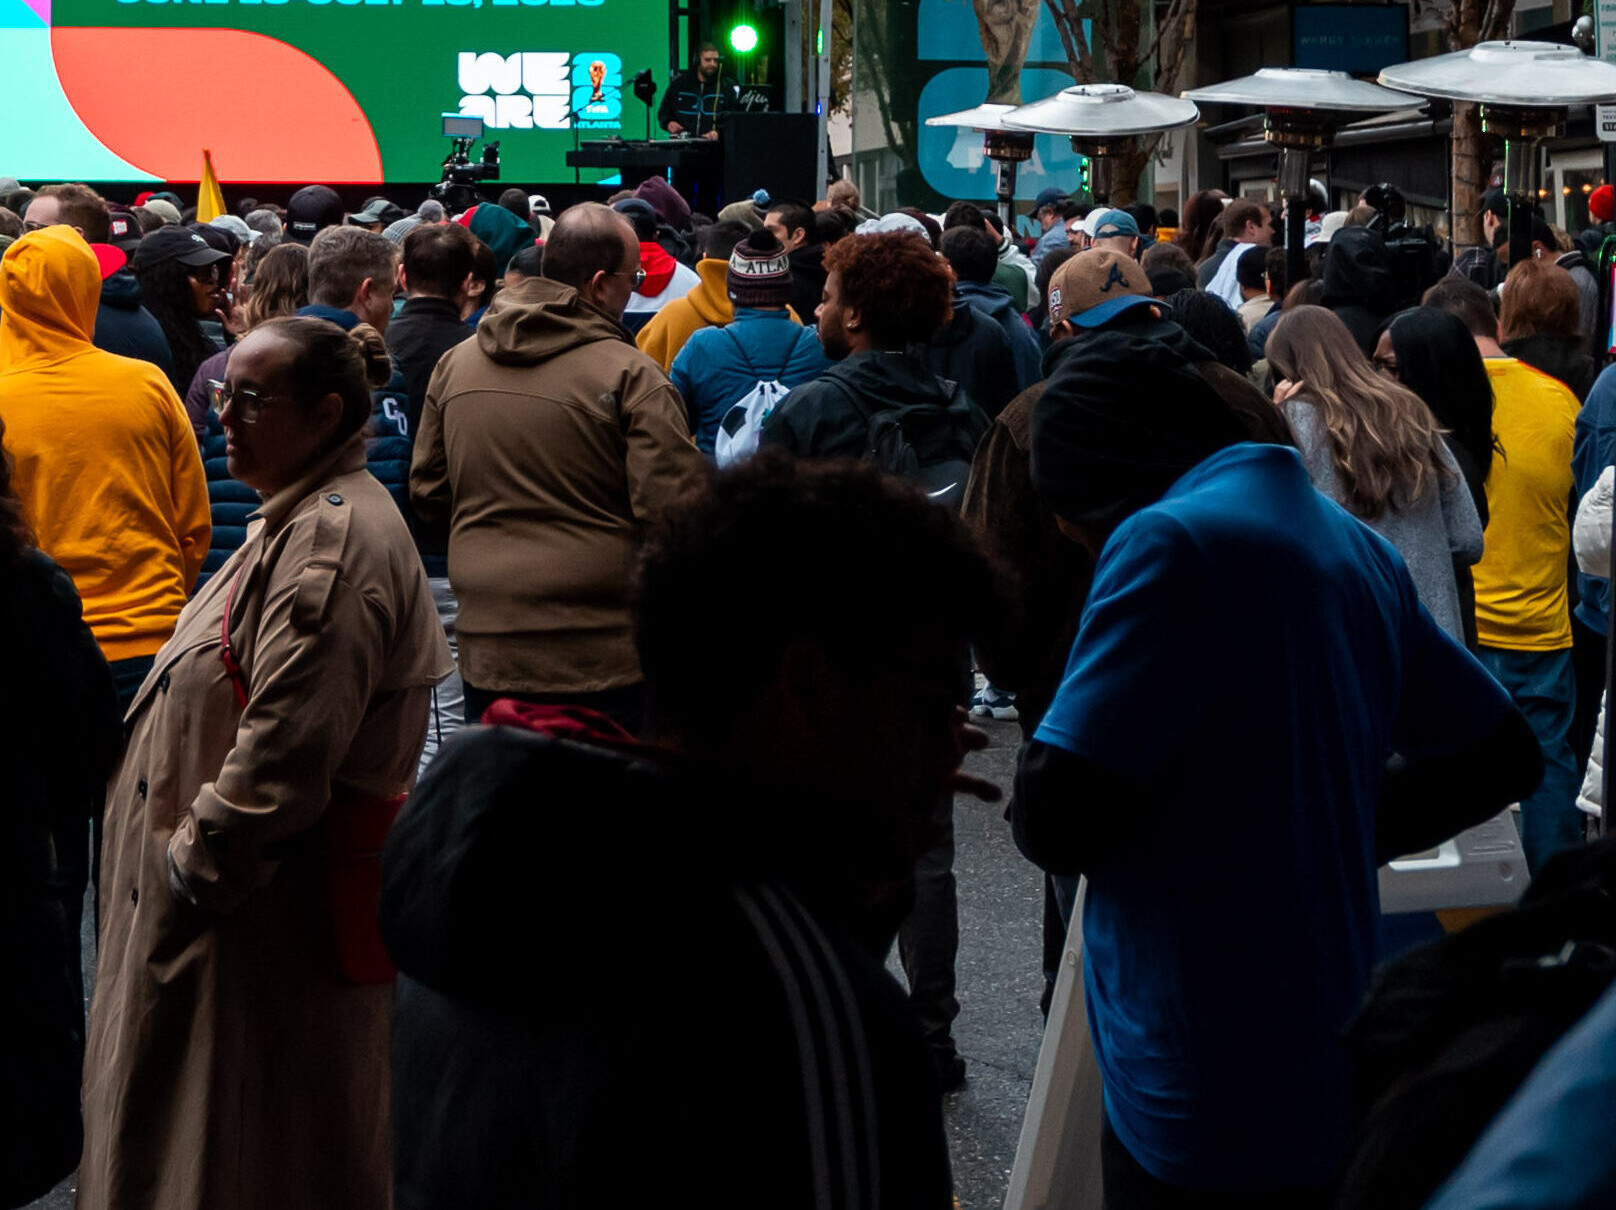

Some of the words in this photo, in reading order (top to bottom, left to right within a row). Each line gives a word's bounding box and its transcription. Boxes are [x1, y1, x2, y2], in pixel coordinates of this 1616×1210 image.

[458, 52, 570, 95] WE
[458, 95, 570, 129] ARE
[585, 104, 609, 114] FIFA
